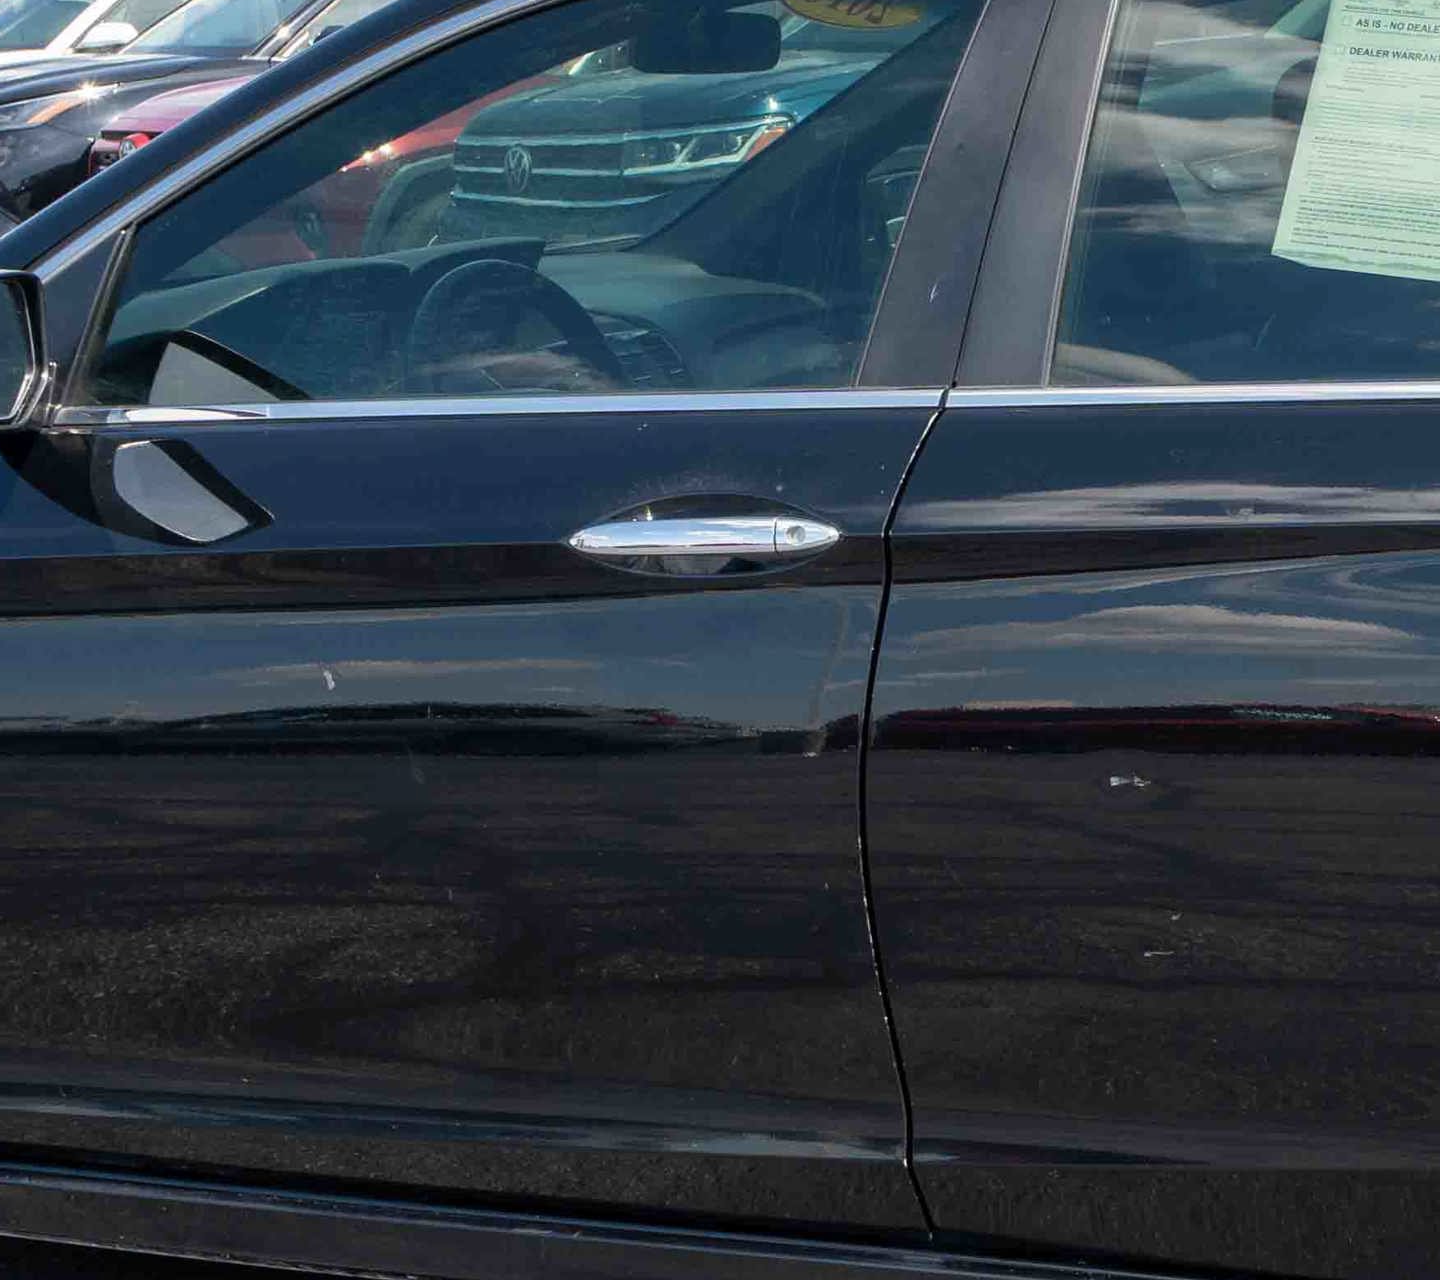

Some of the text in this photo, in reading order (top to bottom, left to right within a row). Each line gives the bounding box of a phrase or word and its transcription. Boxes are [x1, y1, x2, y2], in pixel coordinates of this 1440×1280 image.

[1355, 18, 1370, 29] AS
[1371, 19, 1382, 30] IS
[1389, 21, 1406, 32] NO
[1348, 46, 1390, 59] DEALER
